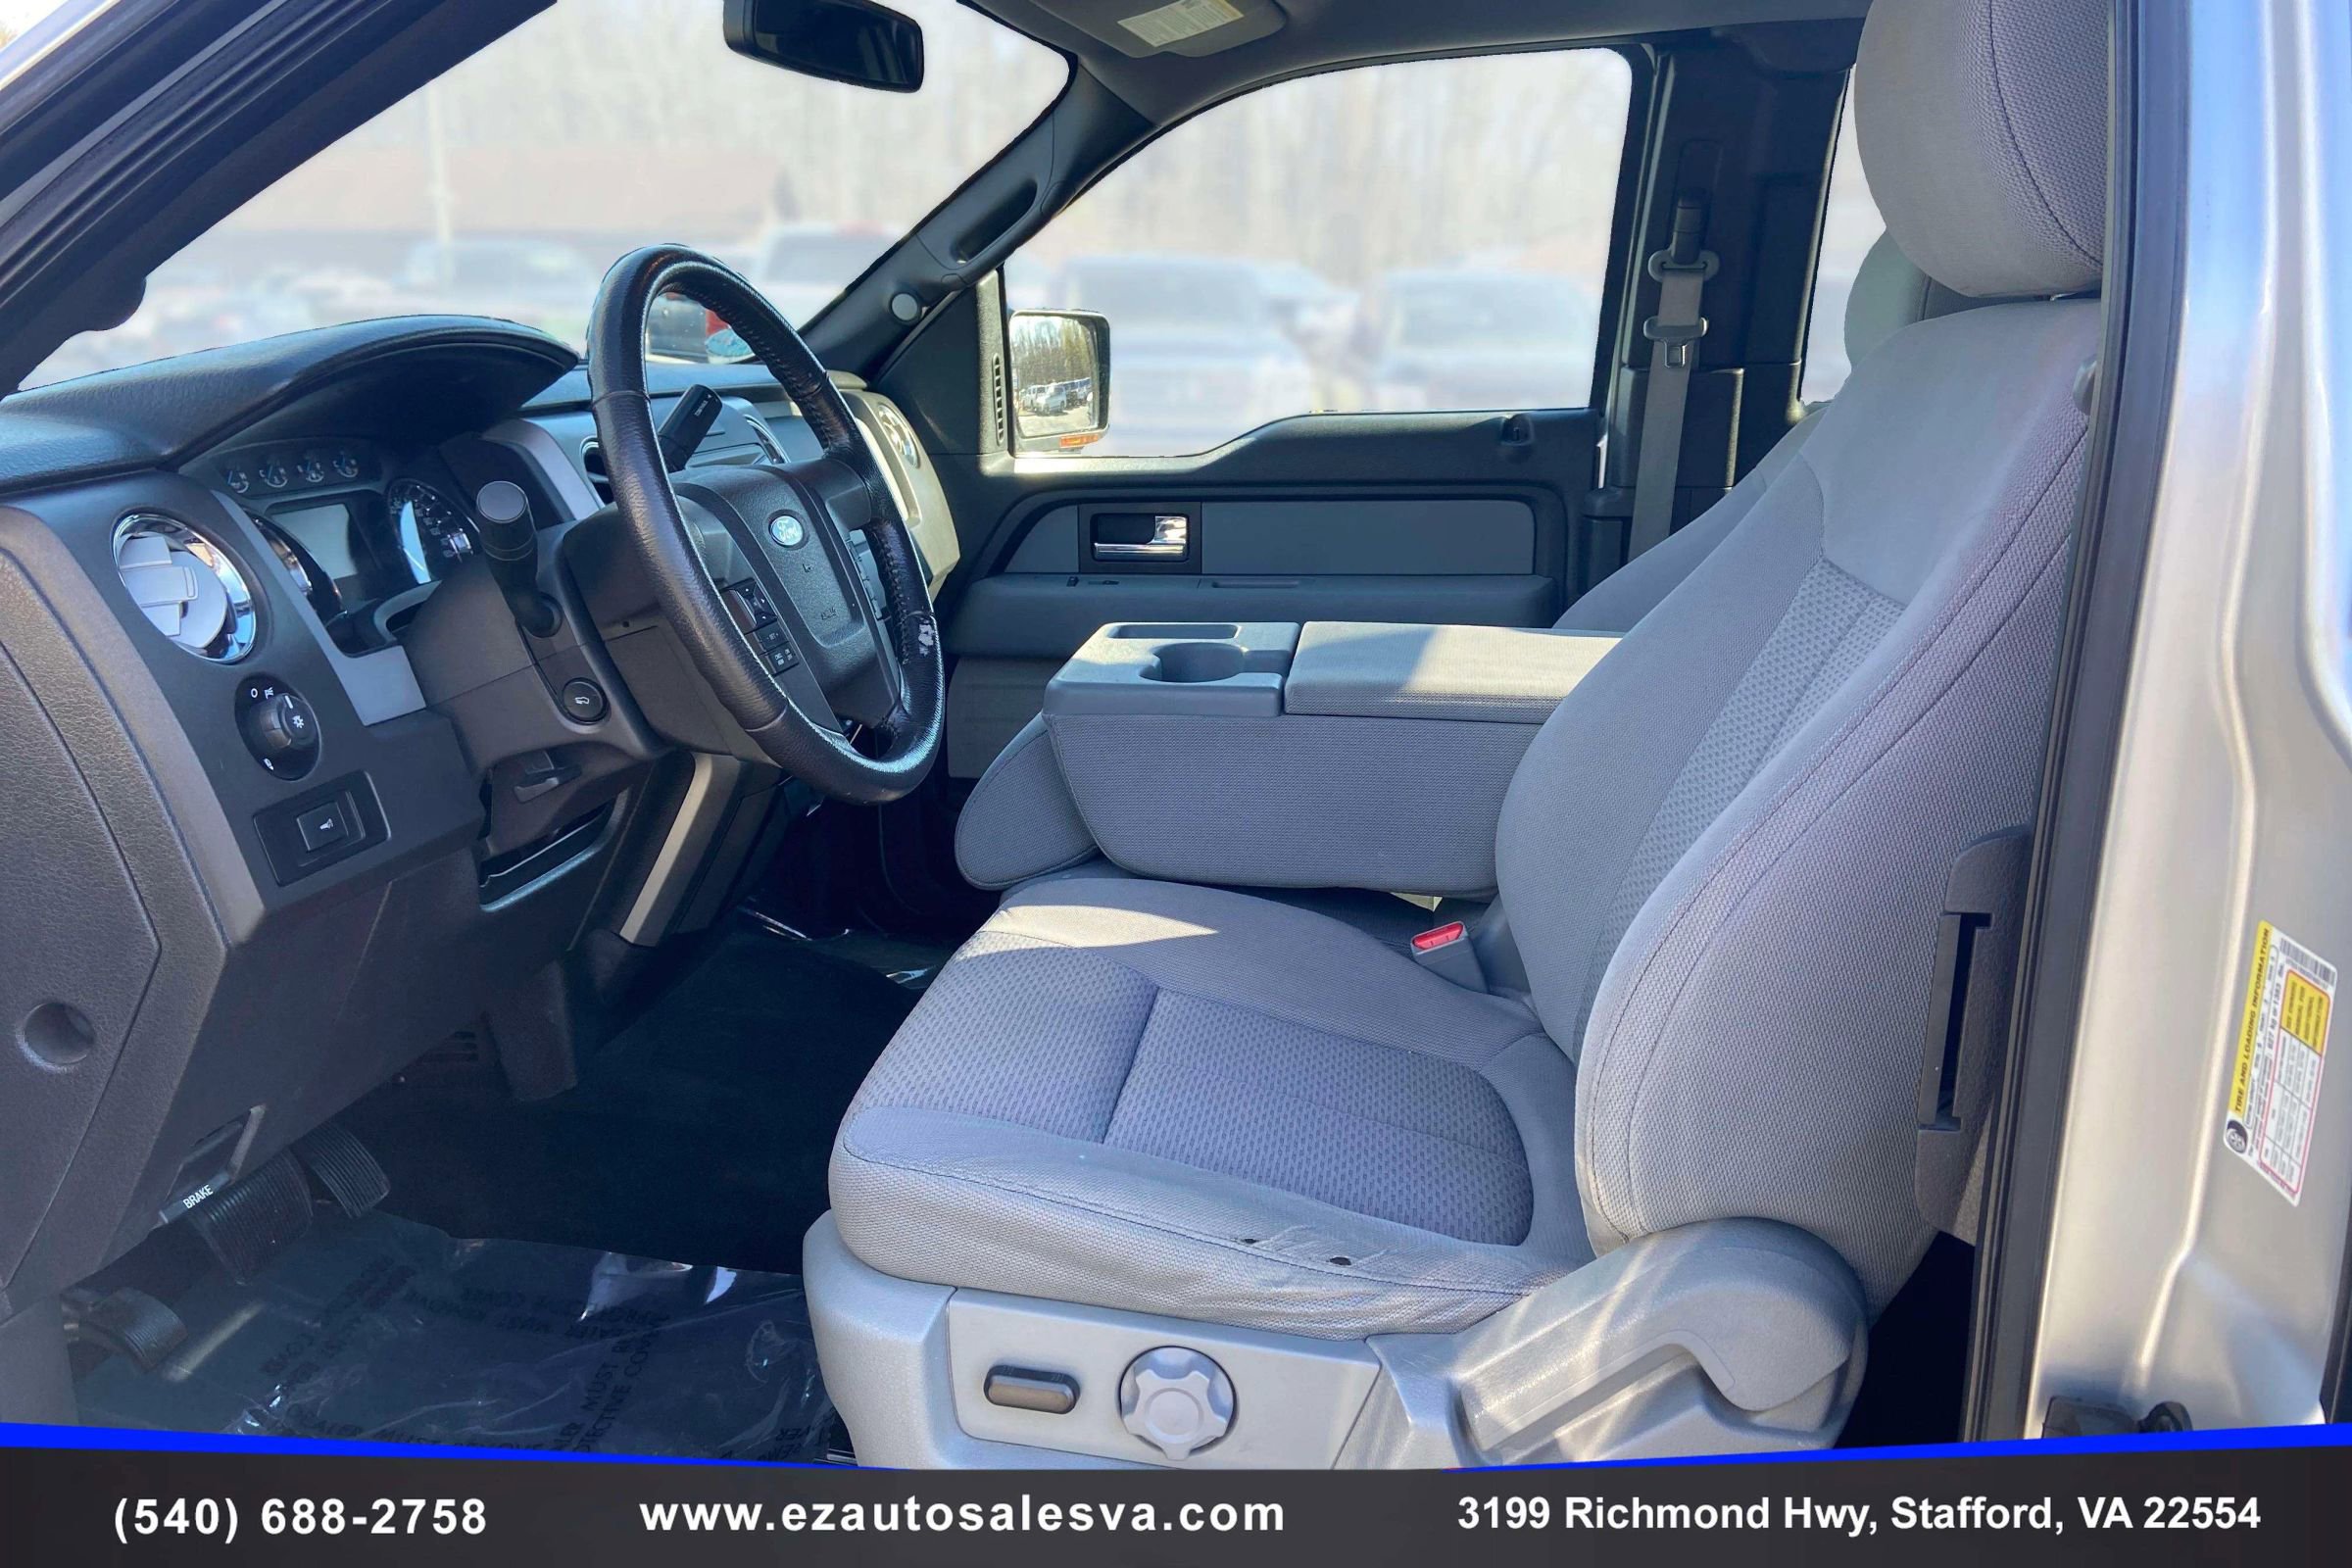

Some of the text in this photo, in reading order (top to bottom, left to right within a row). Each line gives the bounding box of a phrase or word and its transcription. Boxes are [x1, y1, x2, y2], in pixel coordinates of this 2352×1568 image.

[2251, 926, 2270, 1007] INFORMATION
[2243, 1009, 2257, 1059] LOADING
[2239, 1060, 2248, 1085] AND
[2234, 1086, 2244, 1113] TIRE
[182, 1184, 214, 1209] BRAKE
